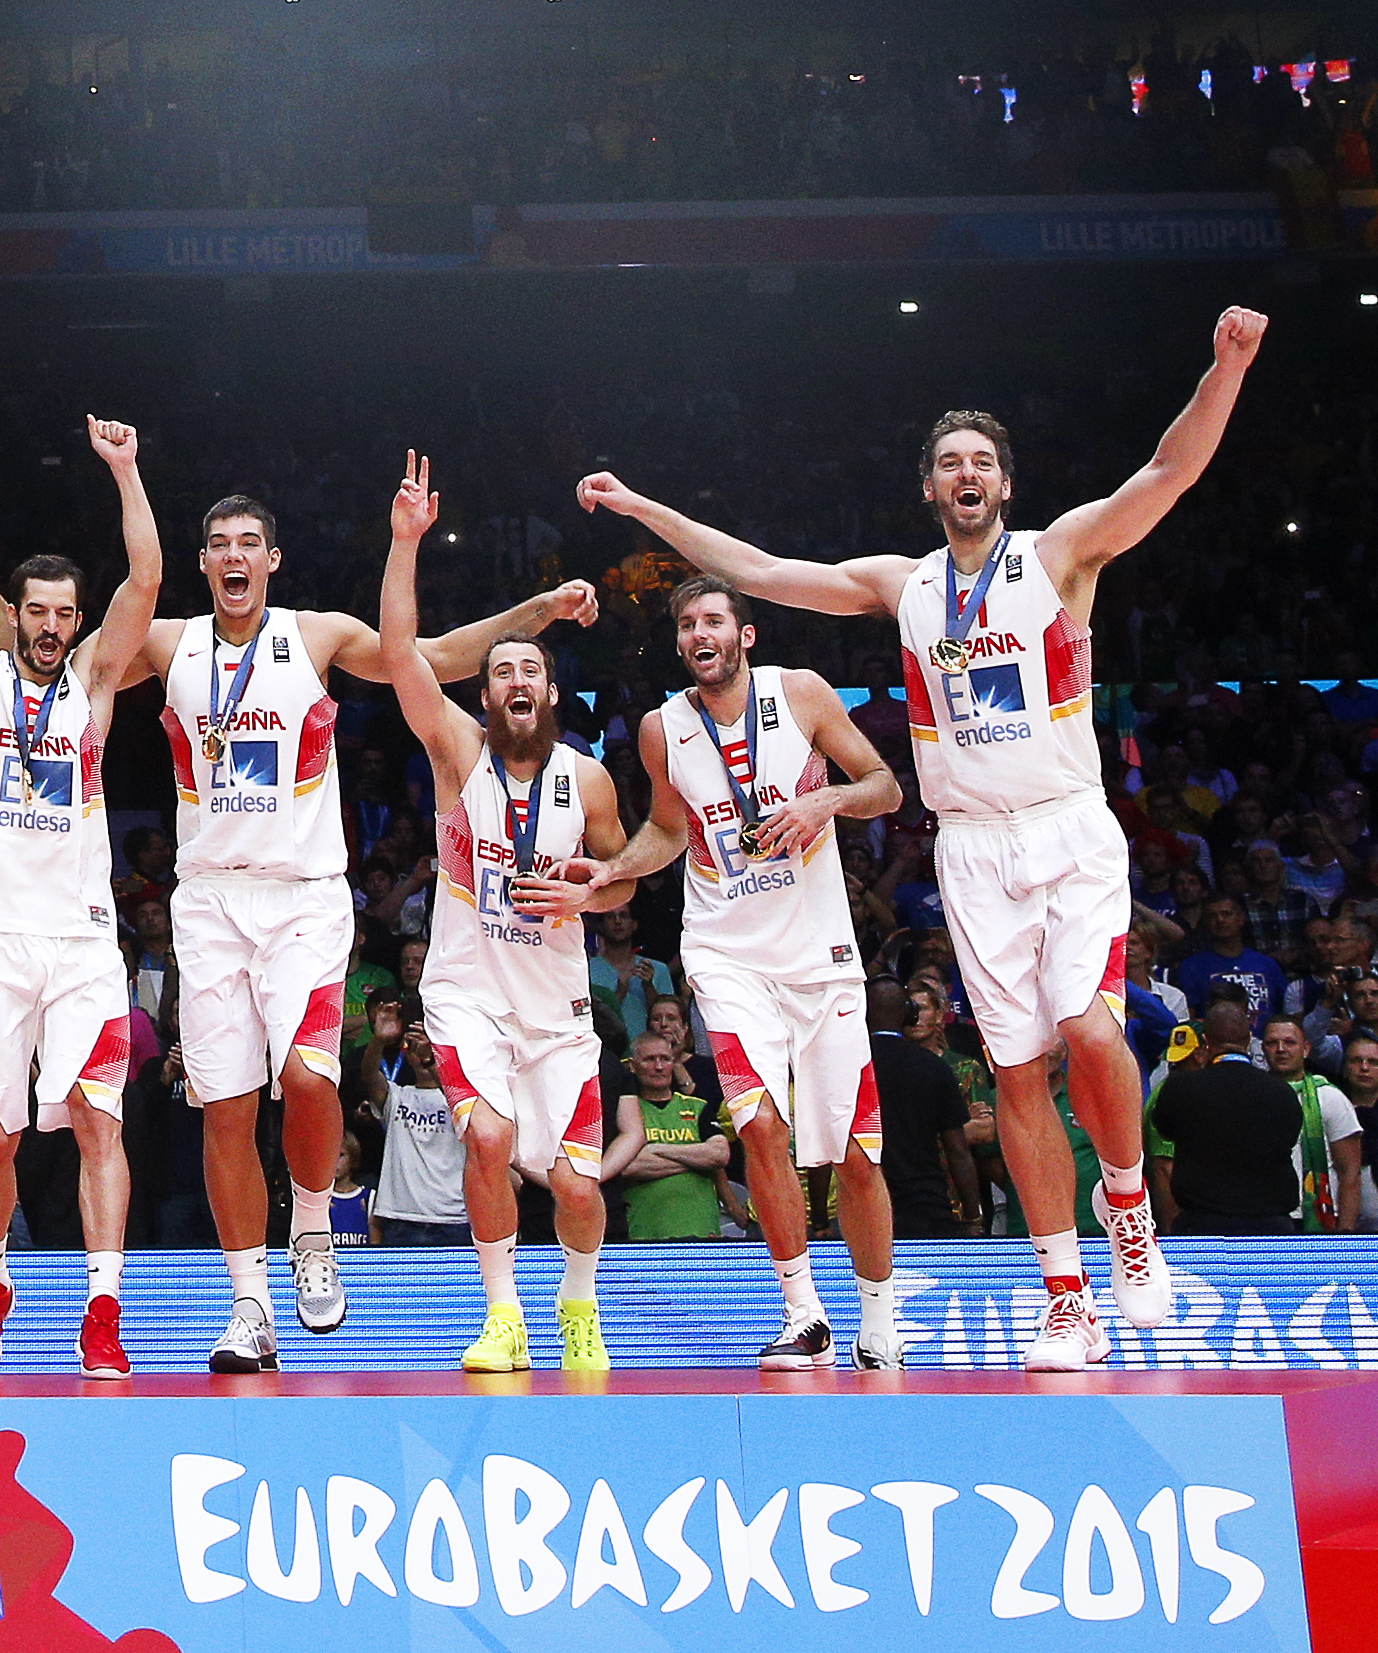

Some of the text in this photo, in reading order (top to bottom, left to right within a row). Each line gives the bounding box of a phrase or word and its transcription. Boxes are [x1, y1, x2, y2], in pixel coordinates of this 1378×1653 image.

[955, 721, 1032, 748] endesa
[720, 738, 756, 786] 5
[210, 791, 278, 814] endesa
[726, 868, 796, 900] endesa
[481, 920, 543, 947] endesa
[645, 1127, 695, 1141] IETUVA
[333, 1232, 368, 1245] RANCE
[169, 1453, 1267, 1626] EUROBASKET 2015
